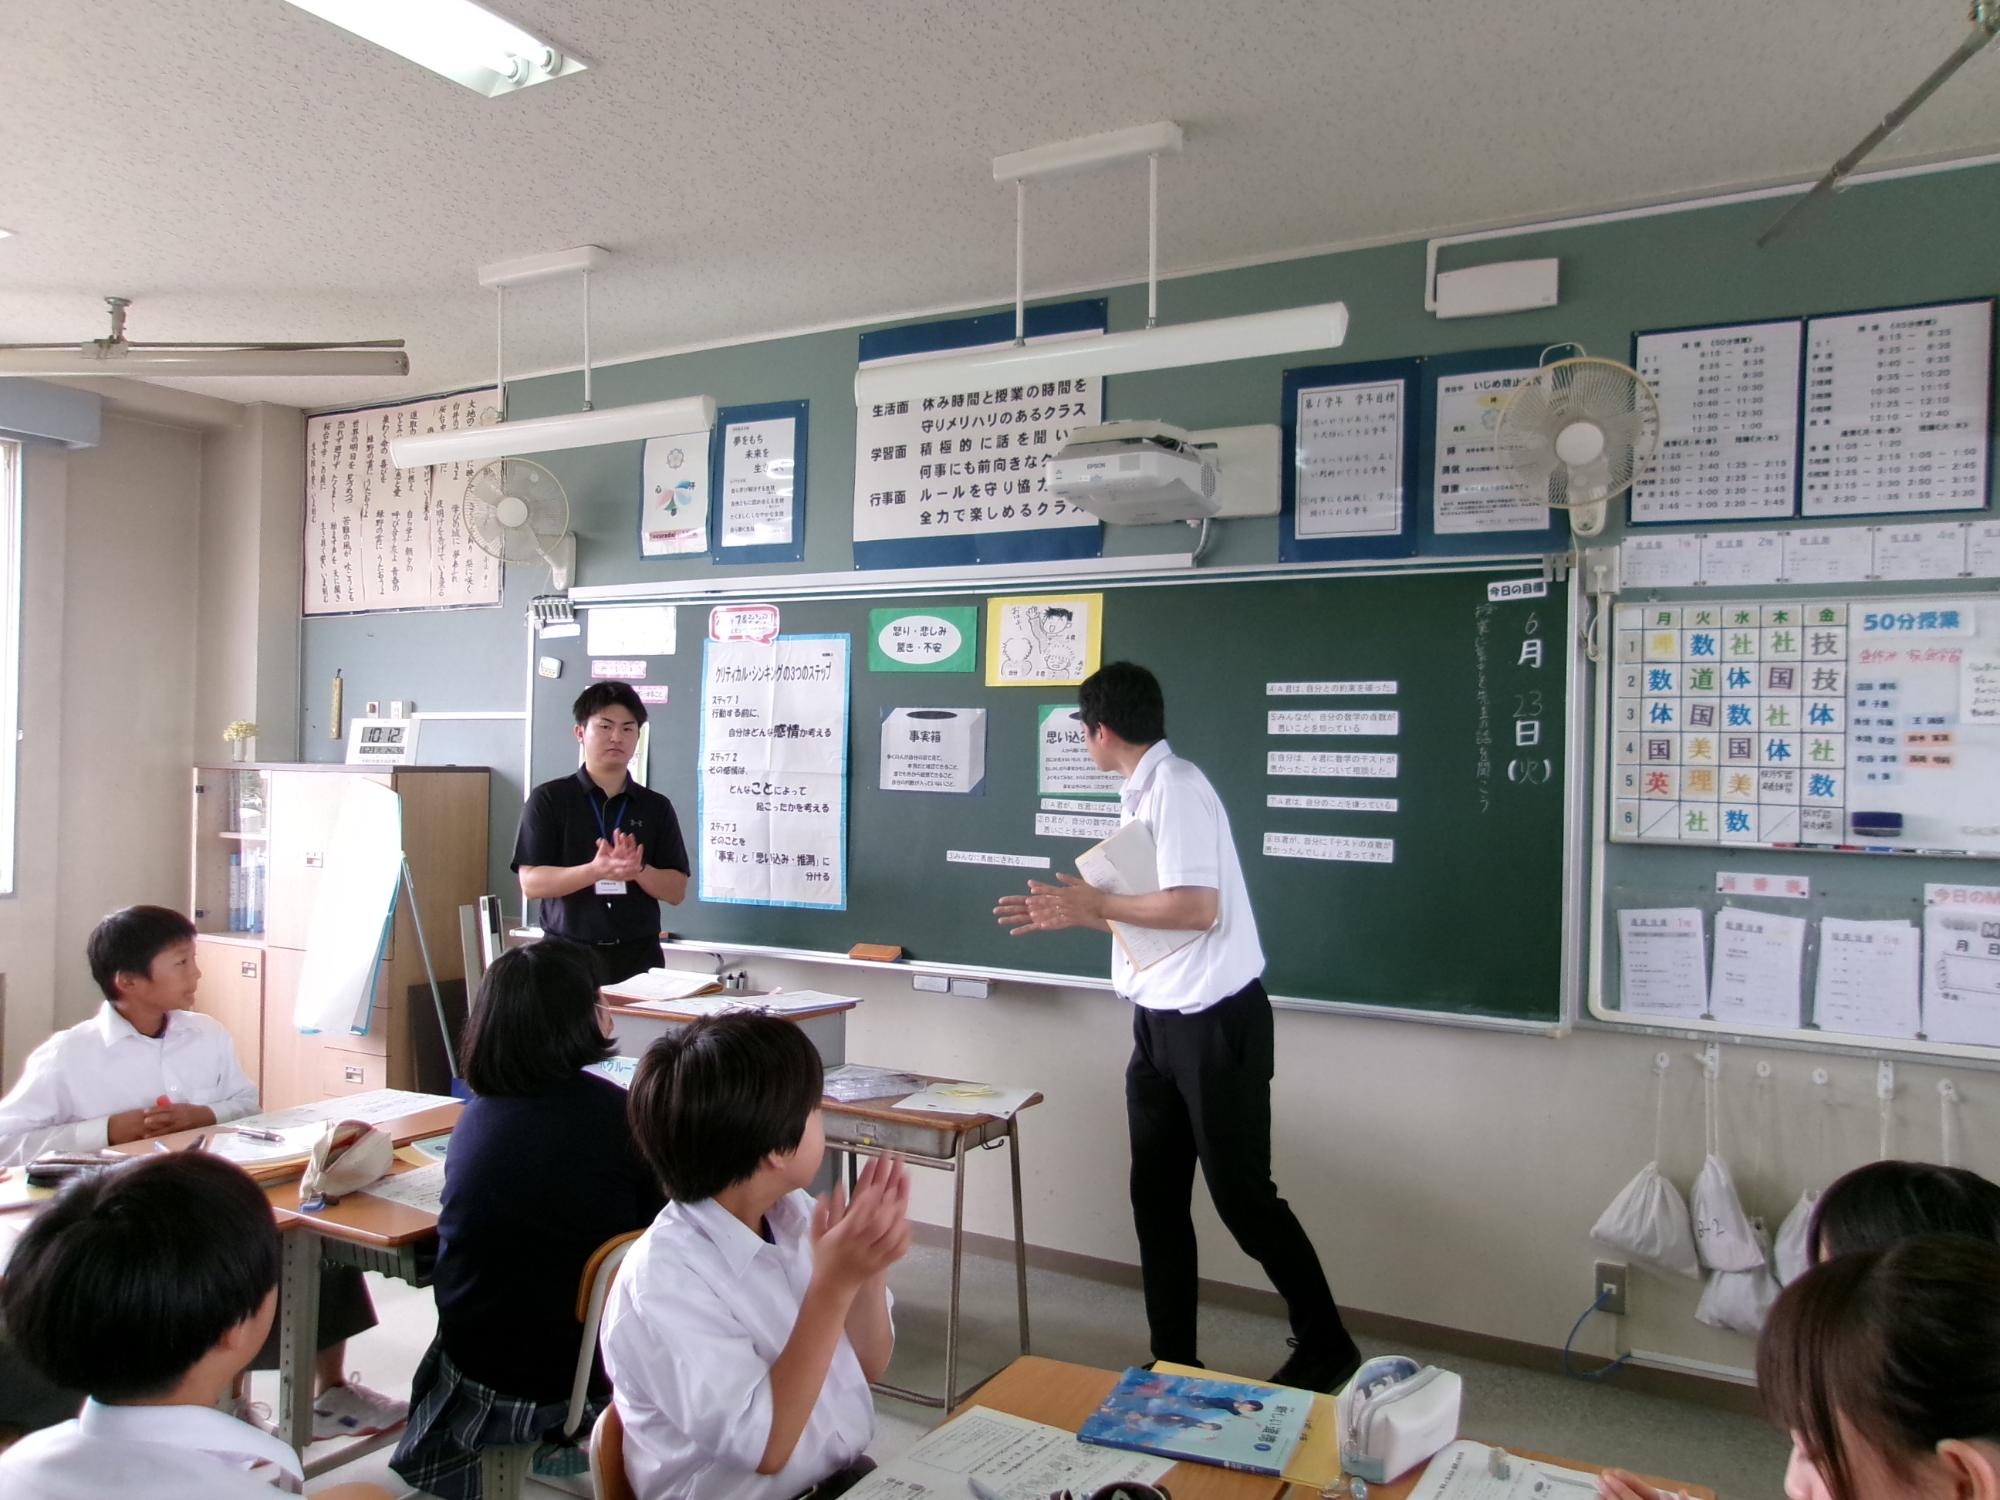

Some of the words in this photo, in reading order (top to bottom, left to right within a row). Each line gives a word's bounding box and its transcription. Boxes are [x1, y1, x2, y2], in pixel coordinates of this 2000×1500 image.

[922, 378, 1087, 410] 休み時間と授業の時間を
[872, 400, 909, 418] 生活面
[921, 402, 1086, 434] 守りメリハリのあるクラス
[733, 434, 763, 447] 夢をもち
[920, 426, 1087, 457] 積極的に話を聞い
[745, 448, 768, 460] 未来を
[871, 444, 907, 462] 学習面
[870, 490, 906, 507] 行事面
[1489, 583, 1545, 597] 今日の目標
[1657, 612, 1670, 625] 月
[1696, 611, 1710, 624] 火
[1735, 611, 1749, 624] 水
[1773, 610, 1788, 624] 木
[1820, 608, 1835, 622] 金
[1863, 610, 1960, 631] 50分授業
[893, 626, 947, 636] 怒り・悲しみ
[896, 642, 942, 653] 驚き・不安
[1629, 641, 1635, 652] 1
[1691, 633, 1715, 656] 数
[1730, 633, 1754, 655] 社
[1772, 631, 1796, 654] 社
[1811, 632, 1838, 655] 技
[715, 661, 832, 684] クリティカル・シンキングの3つのステップ
[1628, 676, 1635, 687] 2
[1648, 669, 1672, 691] 数
[1690, 668, 1714, 690] 道
[1727, 667, 1751, 689] 体
[1769, 667, 1794, 689] 国
[1812, 668, 1839, 691] 技
[712, 708, 760, 718] 行動する前に、
[1627, 709, 1634, 720] 3
[1649, 703, 1673, 724] 体
[1690, 704, 1714, 727] 国
[1728, 704, 1752, 726] 数
[1766, 704, 1791, 727] 社
[1809, 703, 1834, 726] 体
[368, 727, 401, 743] 10:12
[909, 730, 941, 743] 事実箱
[1626, 742, 1633, 753] 4
[1648, 739, 1670, 760] 国
[1688, 738, 1712, 759] 美
[1728, 738, 1751, 759] 国
[1766, 739, 1792, 761] 体
[1809, 738, 1835, 762] 社
[729, 782, 808, 796] どんなことによって
[1625, 775, 1633, 786] 5
[1645, 772, 1670, 794] 英
[1689, 770, 1712, 792] 理
[1728, 773, 1751, 796] 美
[1809, 773, 1835, 798] 数
[756, 802, 830, 813] 起こったかを考える
[1624, 812, 1632, 823] 6
[1686, 810, 1709, 832] 社
[1725, 810, 1750, 832] 数
[710, 836, 746, 846] そのことを
[806, 873, 830, 881] 分ける
